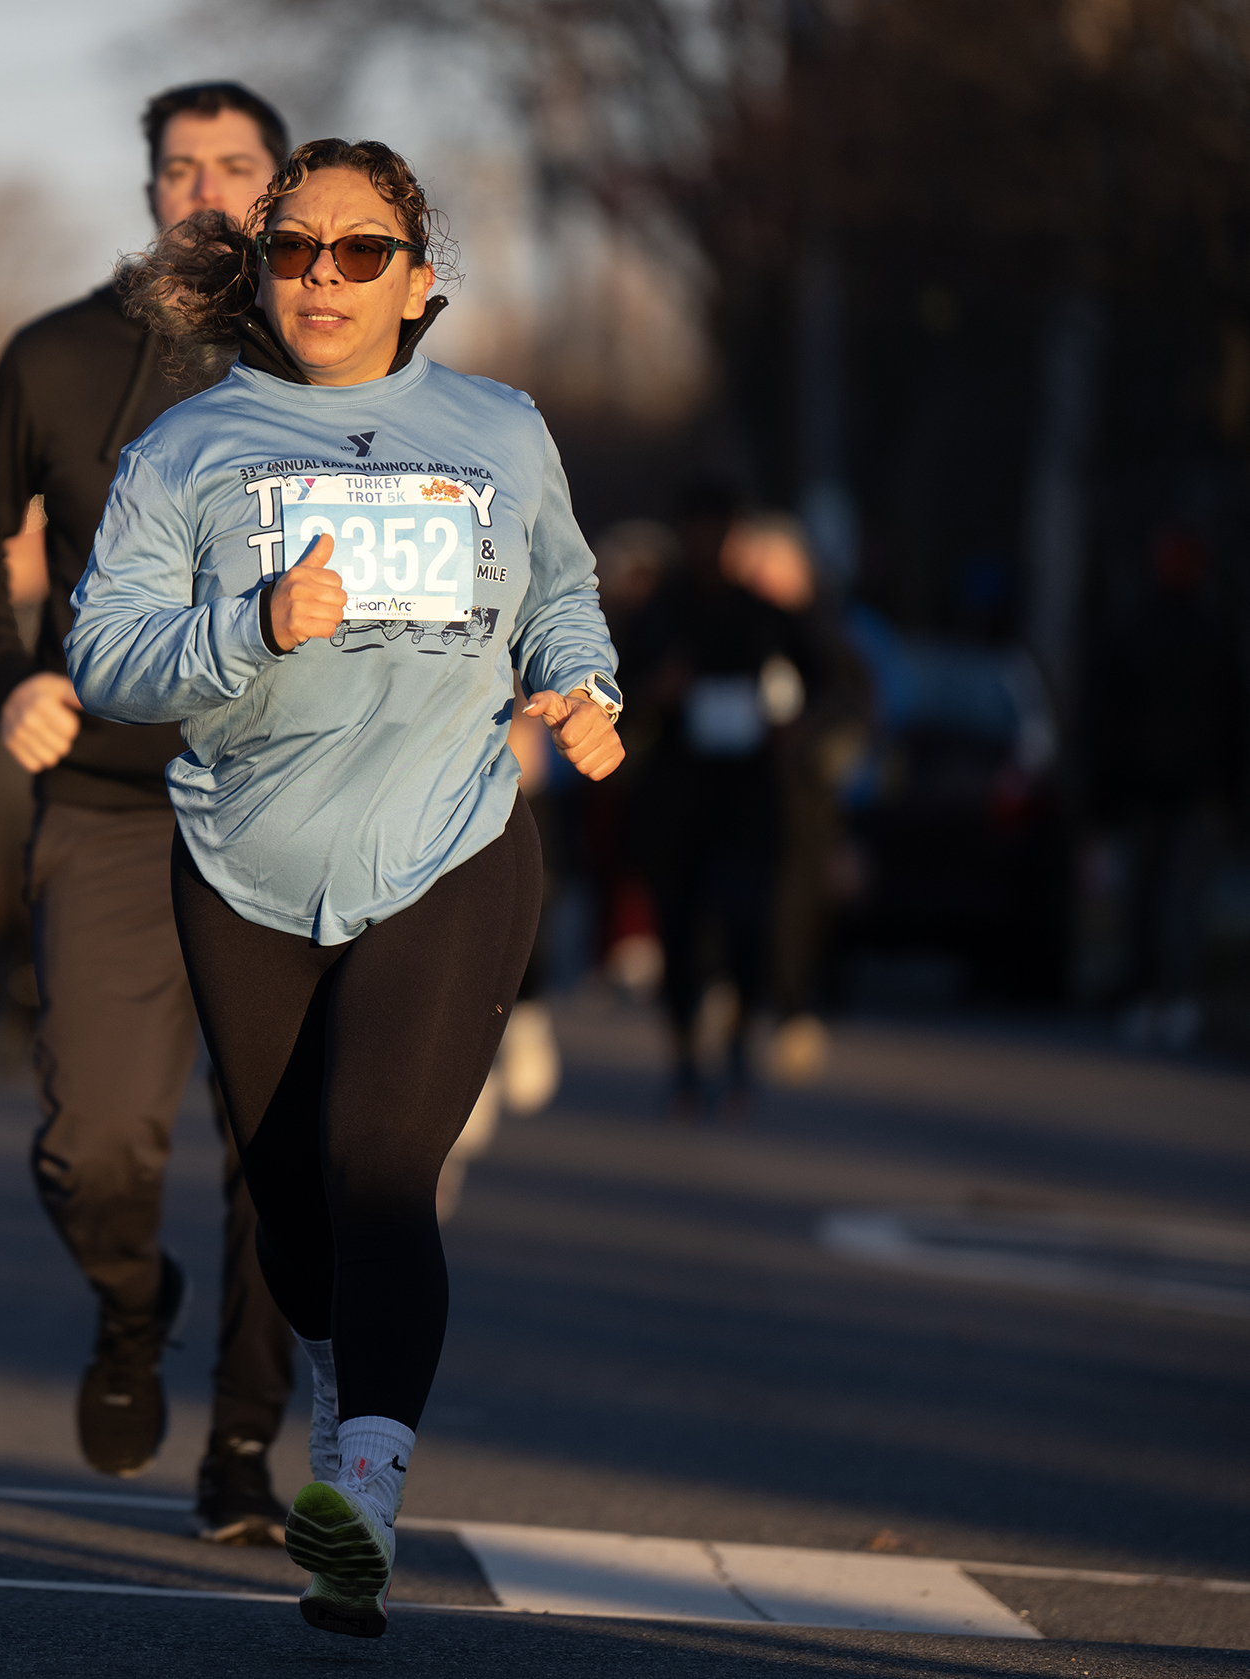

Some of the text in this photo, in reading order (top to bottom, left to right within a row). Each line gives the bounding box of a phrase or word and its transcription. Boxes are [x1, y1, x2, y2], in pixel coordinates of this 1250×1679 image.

[239, 459, 493, 481] 33rd ANNUAL RAPPAHANNOCK AREA YMCA
[345, 477, 402, 489] TURKEY
[346, 491, 406, 503] TROT 5K
[480, 538, 496, 561] &
[476, 564, 507, 582] MILE
